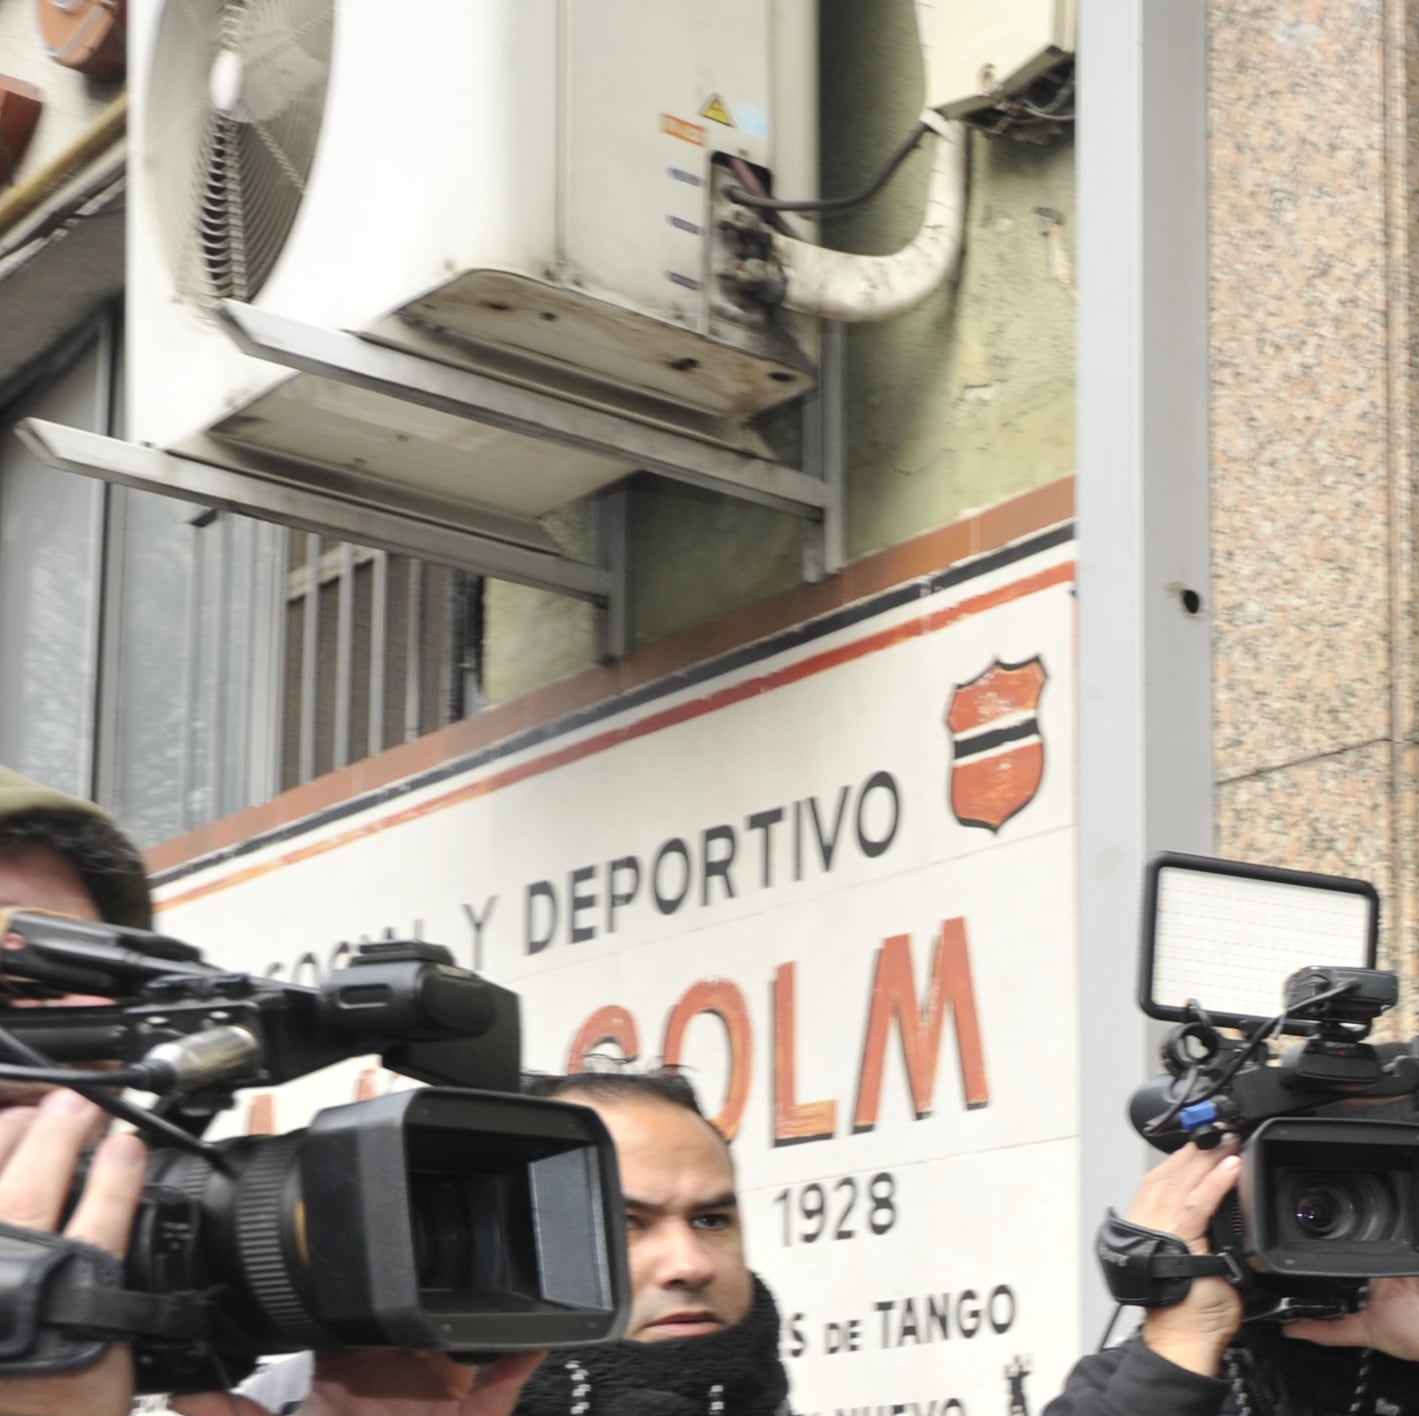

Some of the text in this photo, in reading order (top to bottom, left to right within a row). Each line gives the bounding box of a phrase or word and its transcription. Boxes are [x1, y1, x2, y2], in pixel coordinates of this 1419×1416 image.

[460, 894, 500, 973] Y
[523, 770, 903, 957] DEPORTIVO
[771, 1172, 898, 1248] 1928
[872, 1284, 1017, 1350] TANGO
